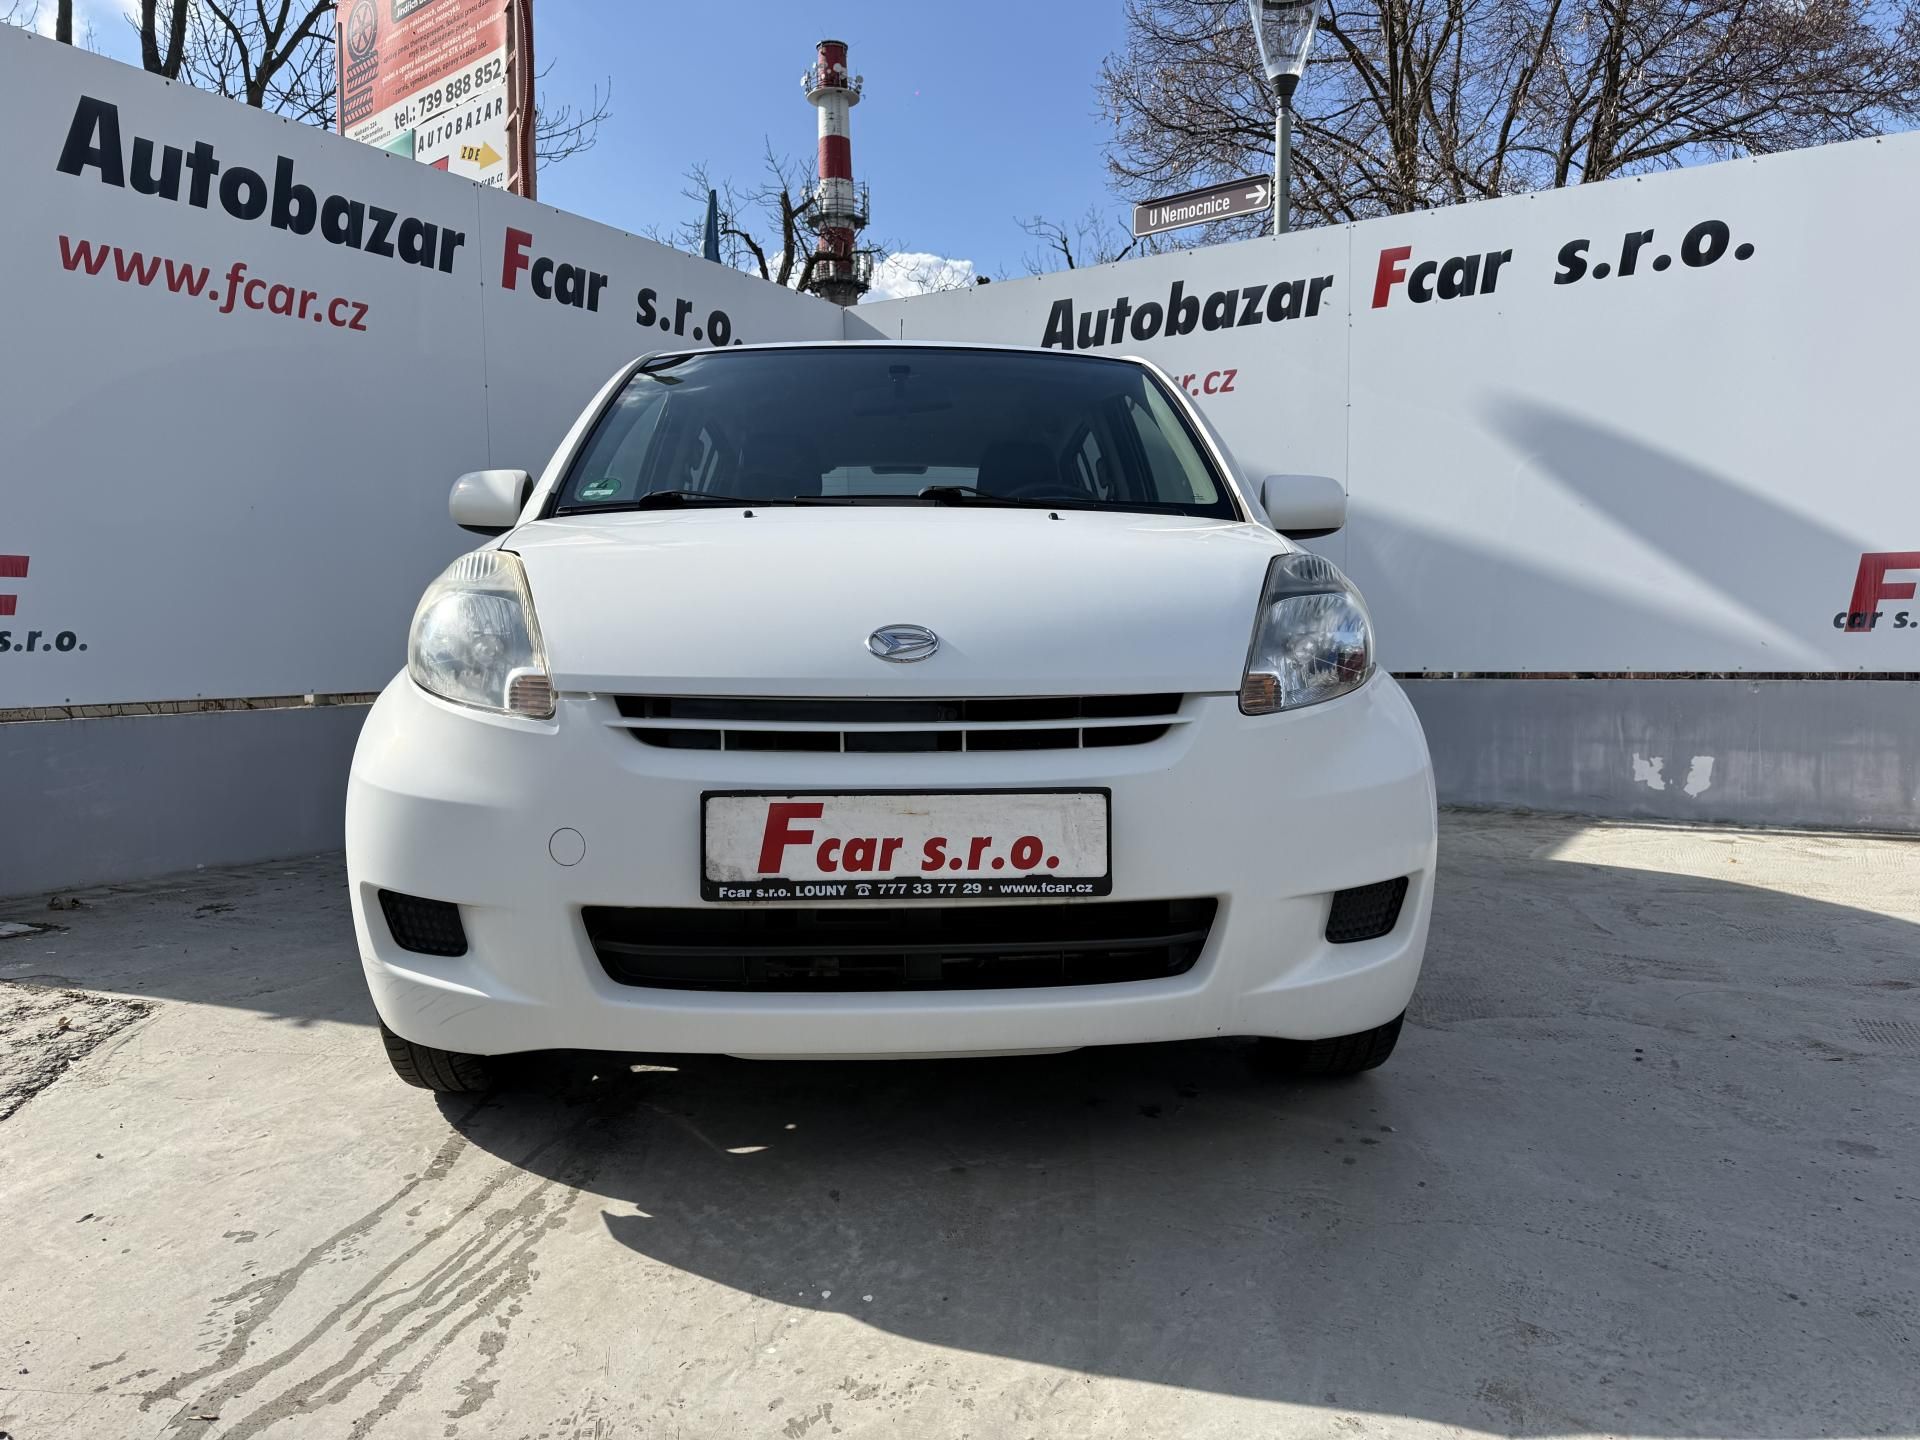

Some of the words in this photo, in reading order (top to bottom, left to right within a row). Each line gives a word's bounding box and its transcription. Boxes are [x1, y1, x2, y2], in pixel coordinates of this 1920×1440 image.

[394, 104, 416, 130] tel.:
[418, 88, 443, 117] 739
[445, 73, 472, 103] 888
[475, 57, 502, 88] 852
[418, 97, 503, 153] AUTOBAZAR
[461, 146, 480, 161] ZDE
[57, 96, 466, 274] Autobazar
[501, 227, 608, 313] Fcar
[1150, 209, 1158, 227] U
[1161, 195, 1230, 224] Nemocnice
[58, 235, 369, 332] www.fcar.cz
[1041, 273, 1334, 350] Autobazar
[1371, 246, 1513, 308] Fcar
[1553, 220, 1755, 285] s.r.o.
[0, 630, 88, 652] s.r.o.
[757, 802, 903, 874] Fcar
[921, 835, 1060, 872] s.r.o.
[718, 886, 752, 898] Fcar
[755, 887, 791, 898] s.r.o.
[795, 885, 848, 897] LOUNY
[877, 883, 907, 895] 777
[912, 883, 933, 895] 33
[937, 883, 957, 895] 77
[962, 882, 982, 894] 29
[1000, 882, 1093, 894] www.fcar.cz
